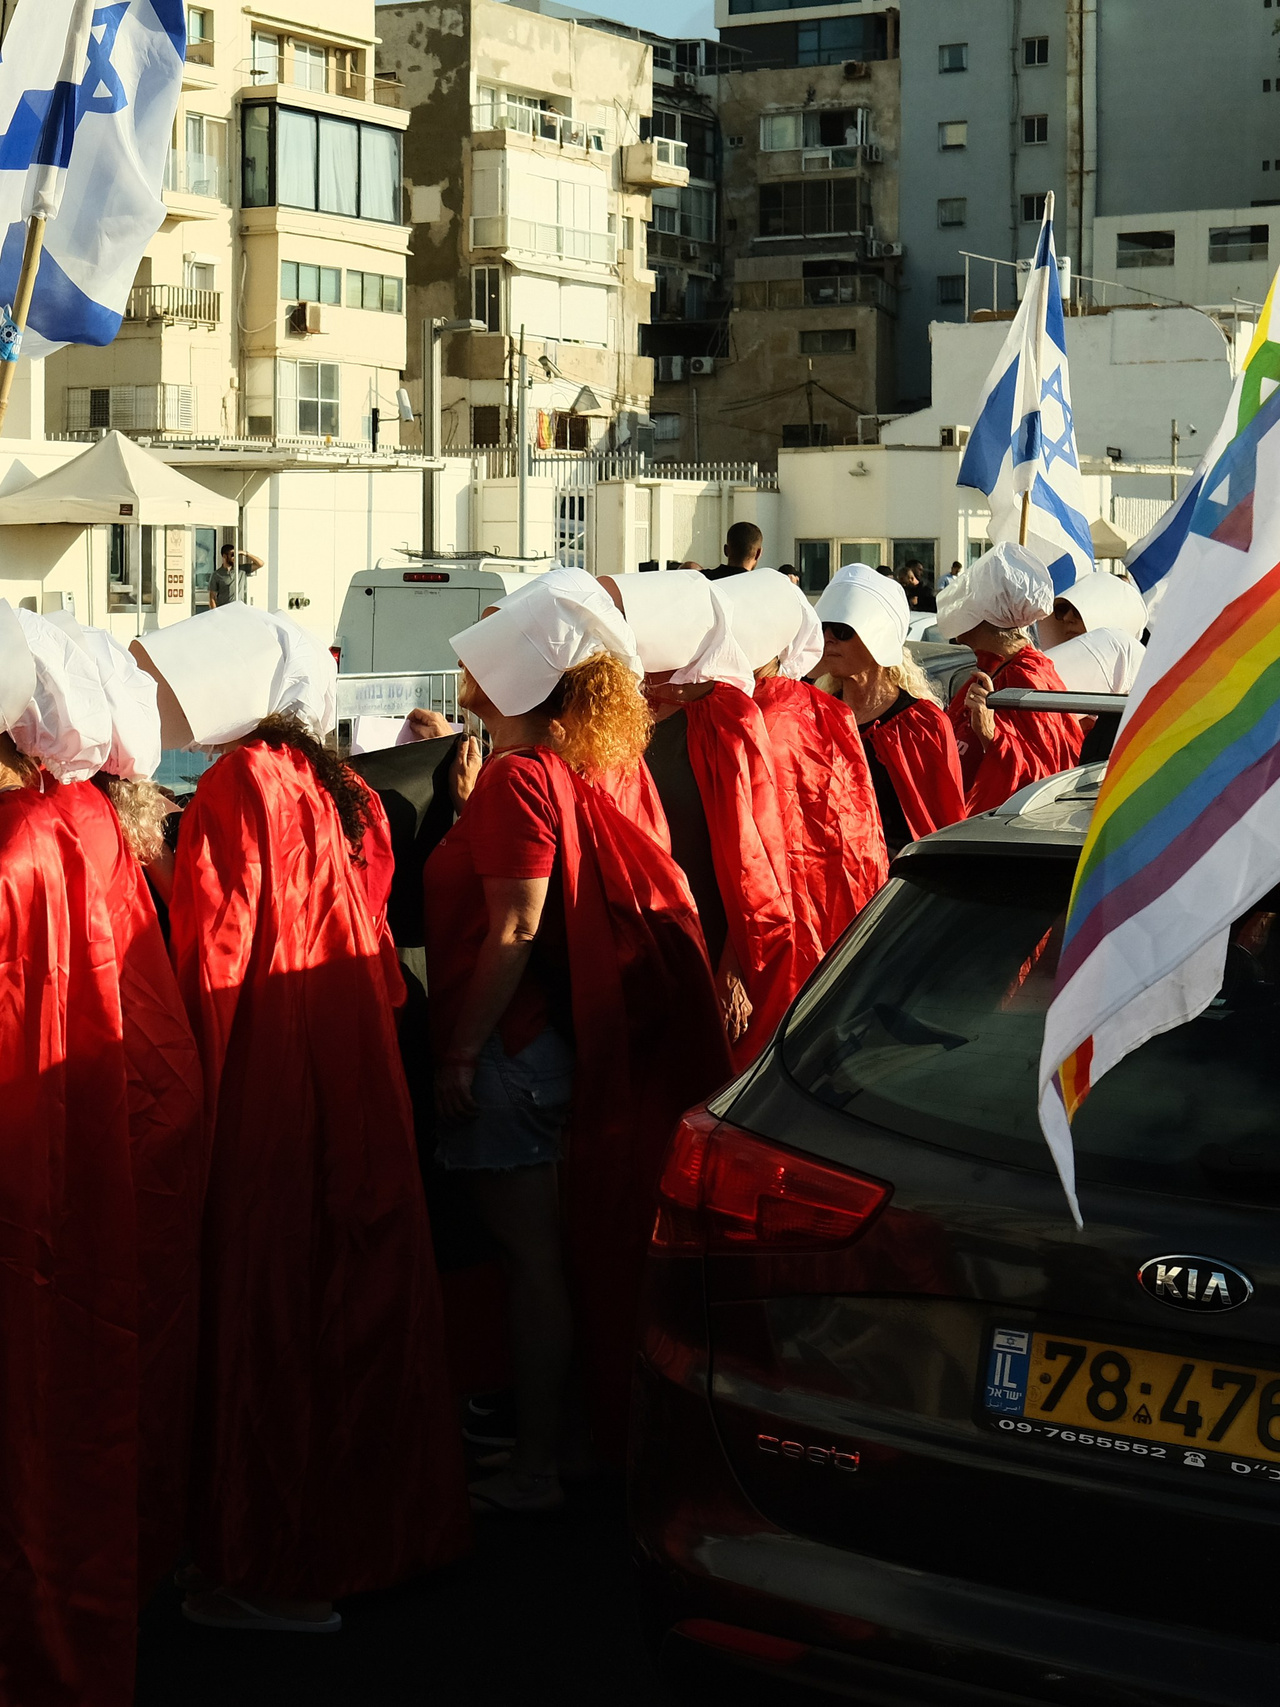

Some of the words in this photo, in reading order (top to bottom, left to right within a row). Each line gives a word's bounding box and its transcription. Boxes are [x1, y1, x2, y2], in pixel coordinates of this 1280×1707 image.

[1156, 1264, 1233, 1305] KIA
[994, 1352, 1018, 1389] IL
[987, 1385, 1023, 1401] ישראל
[998, 1418, 1168, 1459] 09-7655552
